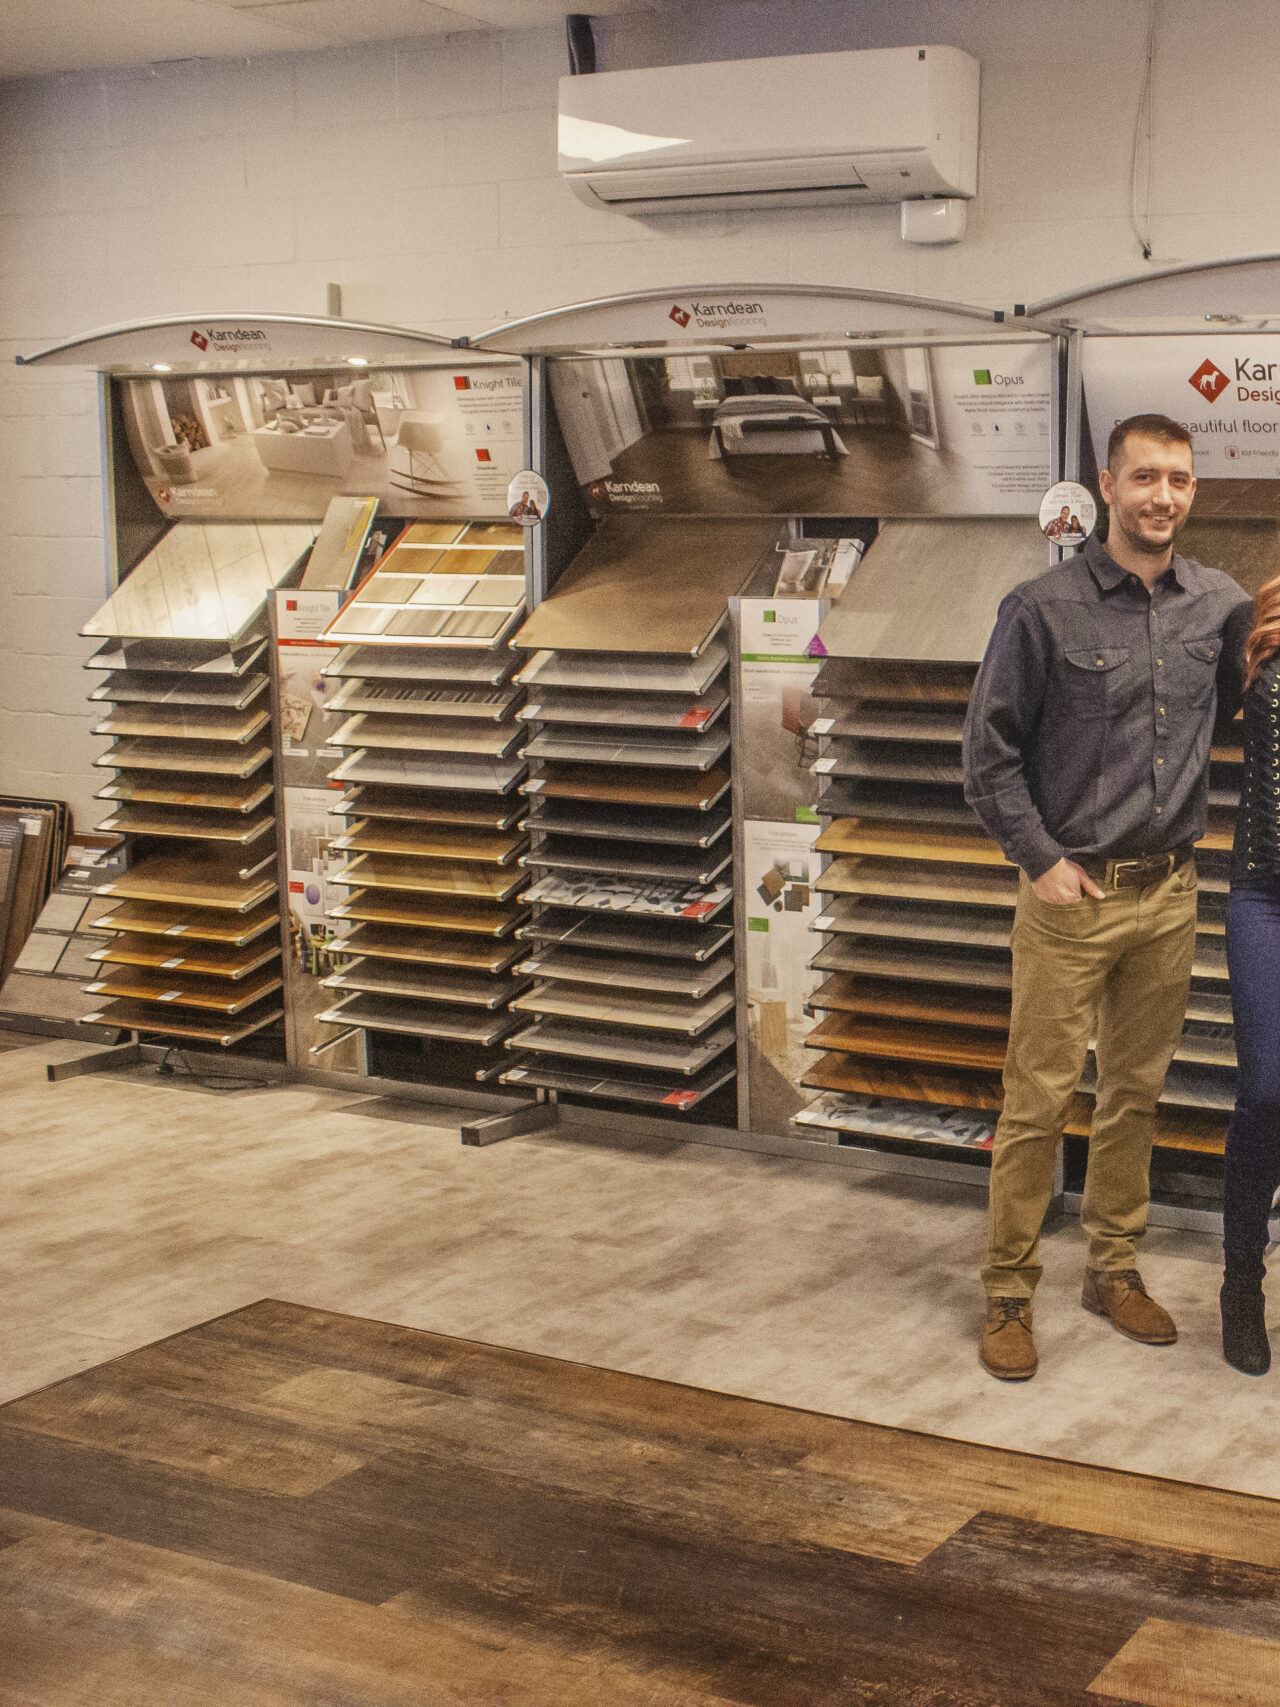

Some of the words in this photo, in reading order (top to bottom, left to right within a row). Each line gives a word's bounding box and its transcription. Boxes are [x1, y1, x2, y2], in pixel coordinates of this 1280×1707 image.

[691, 302, 763, 316] Karndean
[206, 328, 266, 341] Karndean
[473, 379, 505, 391] Knight
[994, 374, 1024, 388] Opus
[1182, 419, 1238, 433] eautiful
[604, 481, 660, 493] Karndean
